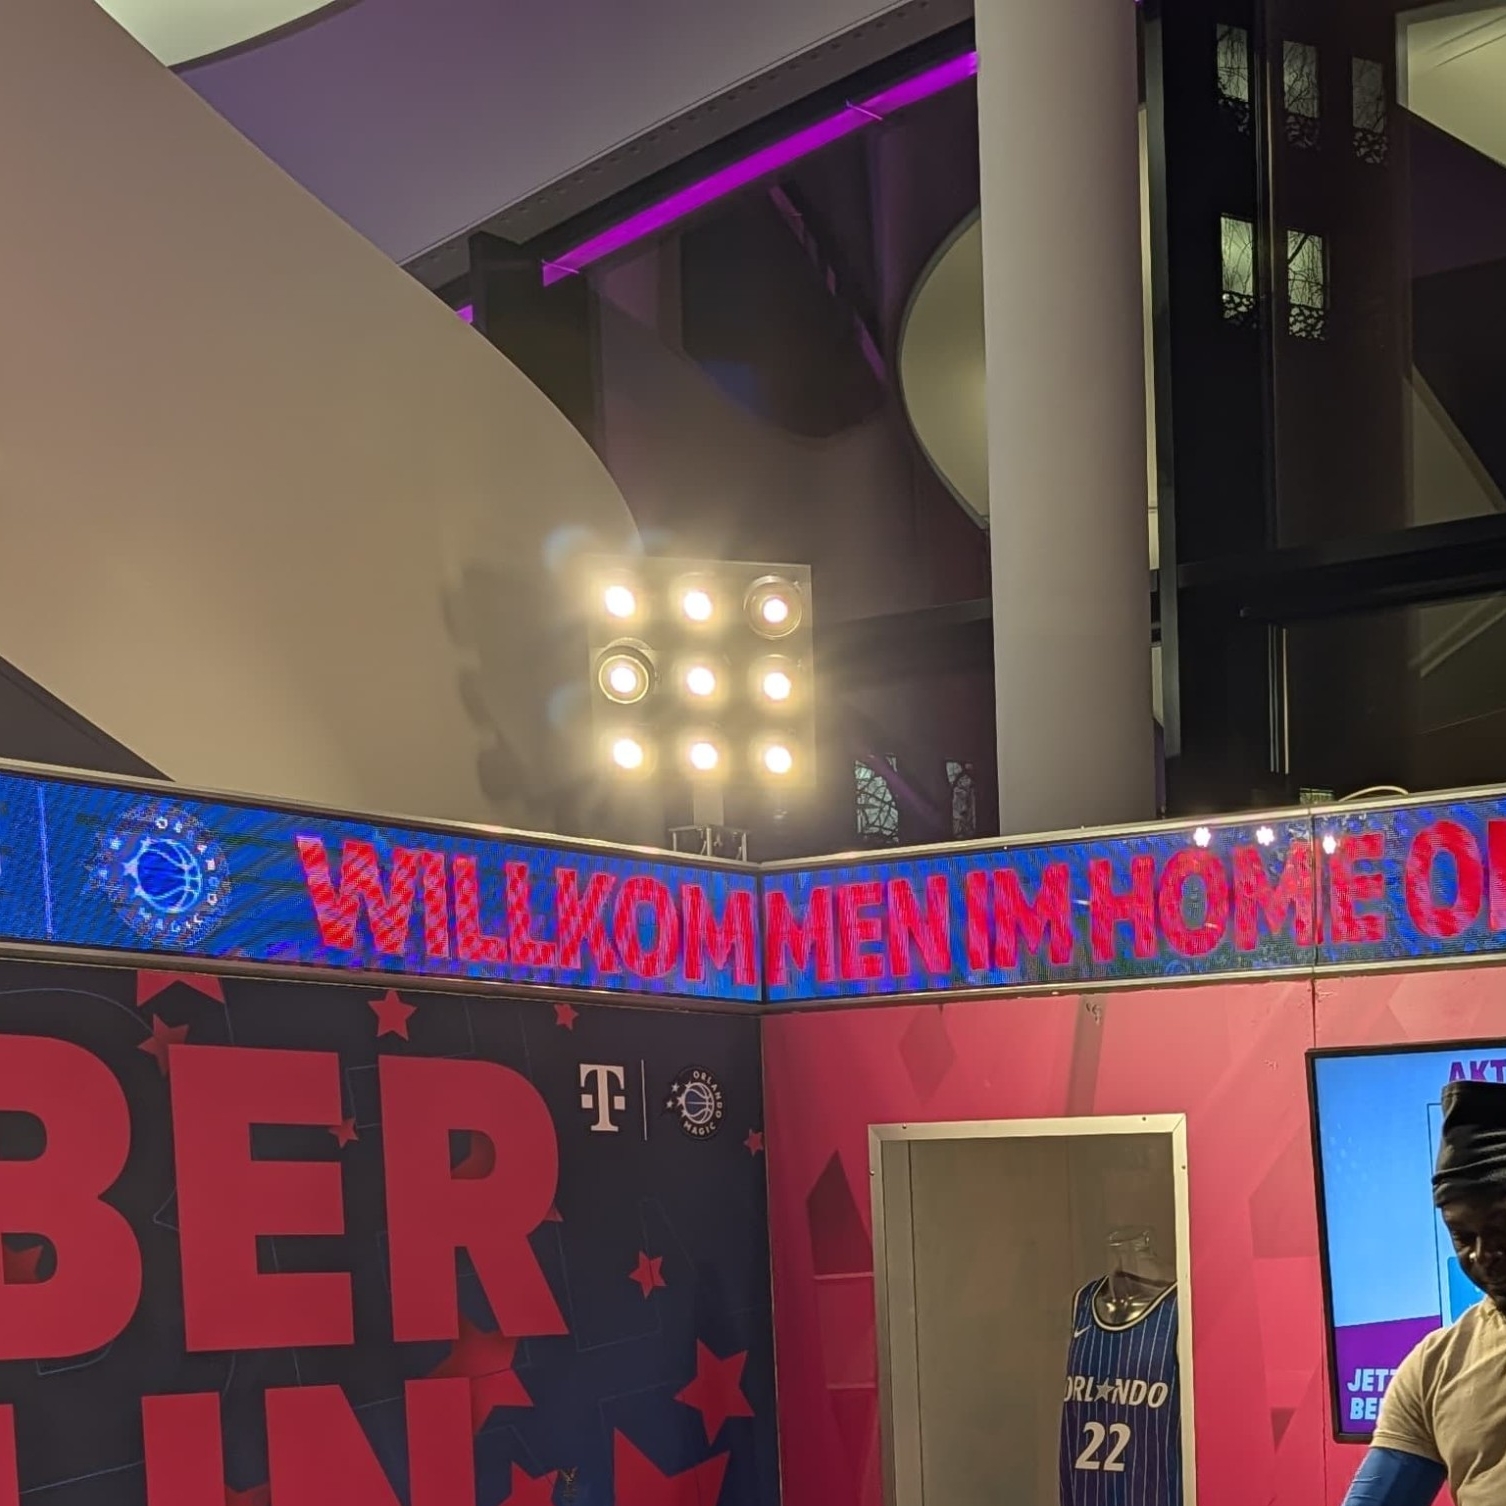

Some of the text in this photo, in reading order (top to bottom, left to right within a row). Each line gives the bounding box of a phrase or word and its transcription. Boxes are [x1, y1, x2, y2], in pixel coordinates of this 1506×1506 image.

[296, 835, 952, 987] WILLKOMMEN
[966, 861, 1074, 972] IM
[1087, 831, 1387, 965] HOME
[579, 1063, 627, 1132] T
[692, 1070, 723, 1119] ORLANDO
[683, 1120, 717, 1136] MAGIC
[0, 1033, 570, 1361] BER
[1074, 1421, 1132, 1472] 22
